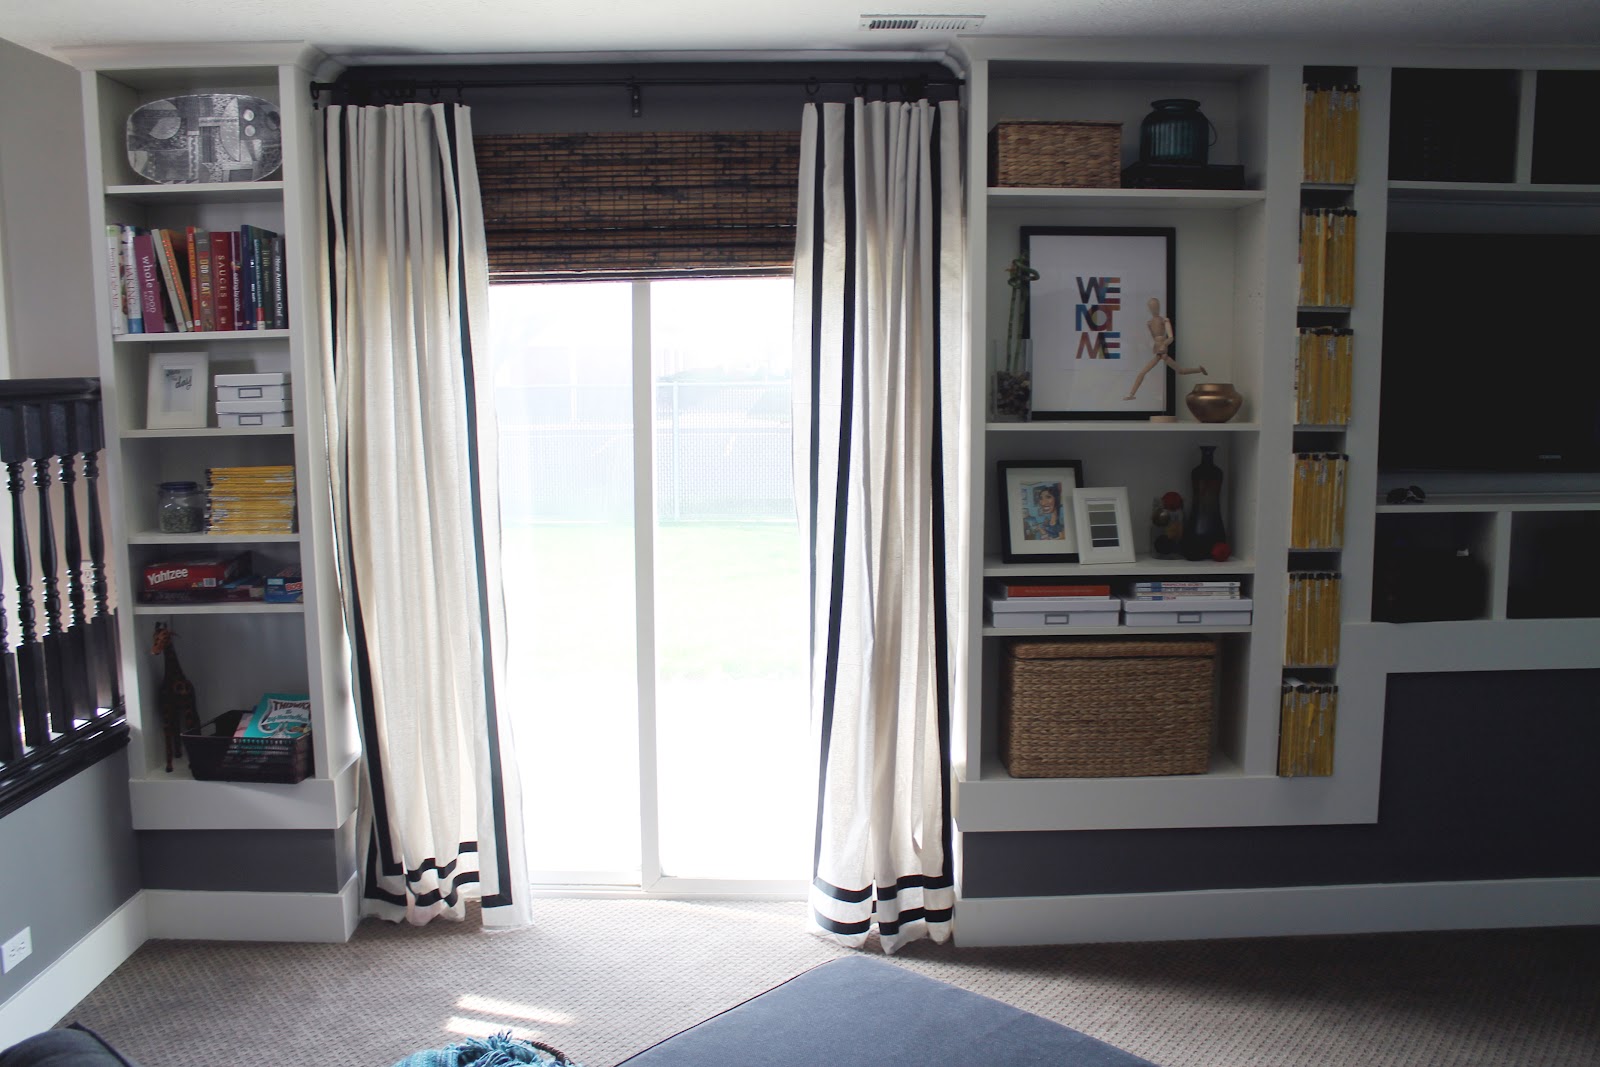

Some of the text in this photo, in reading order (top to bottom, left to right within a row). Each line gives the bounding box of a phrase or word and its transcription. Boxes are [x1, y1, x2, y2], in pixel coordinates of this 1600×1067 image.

[141, 255, 157, 313] whole FOOD
[217, 255, 227, 298] SAUCES
[1075, 276, 1121, 304] WE
[1075, 304, 1121, 332] NOT
[1075, 332, 1121, 359] ME
[175, 375, 193, 391] day
[147, 568, 189, 586] Yahtzee
